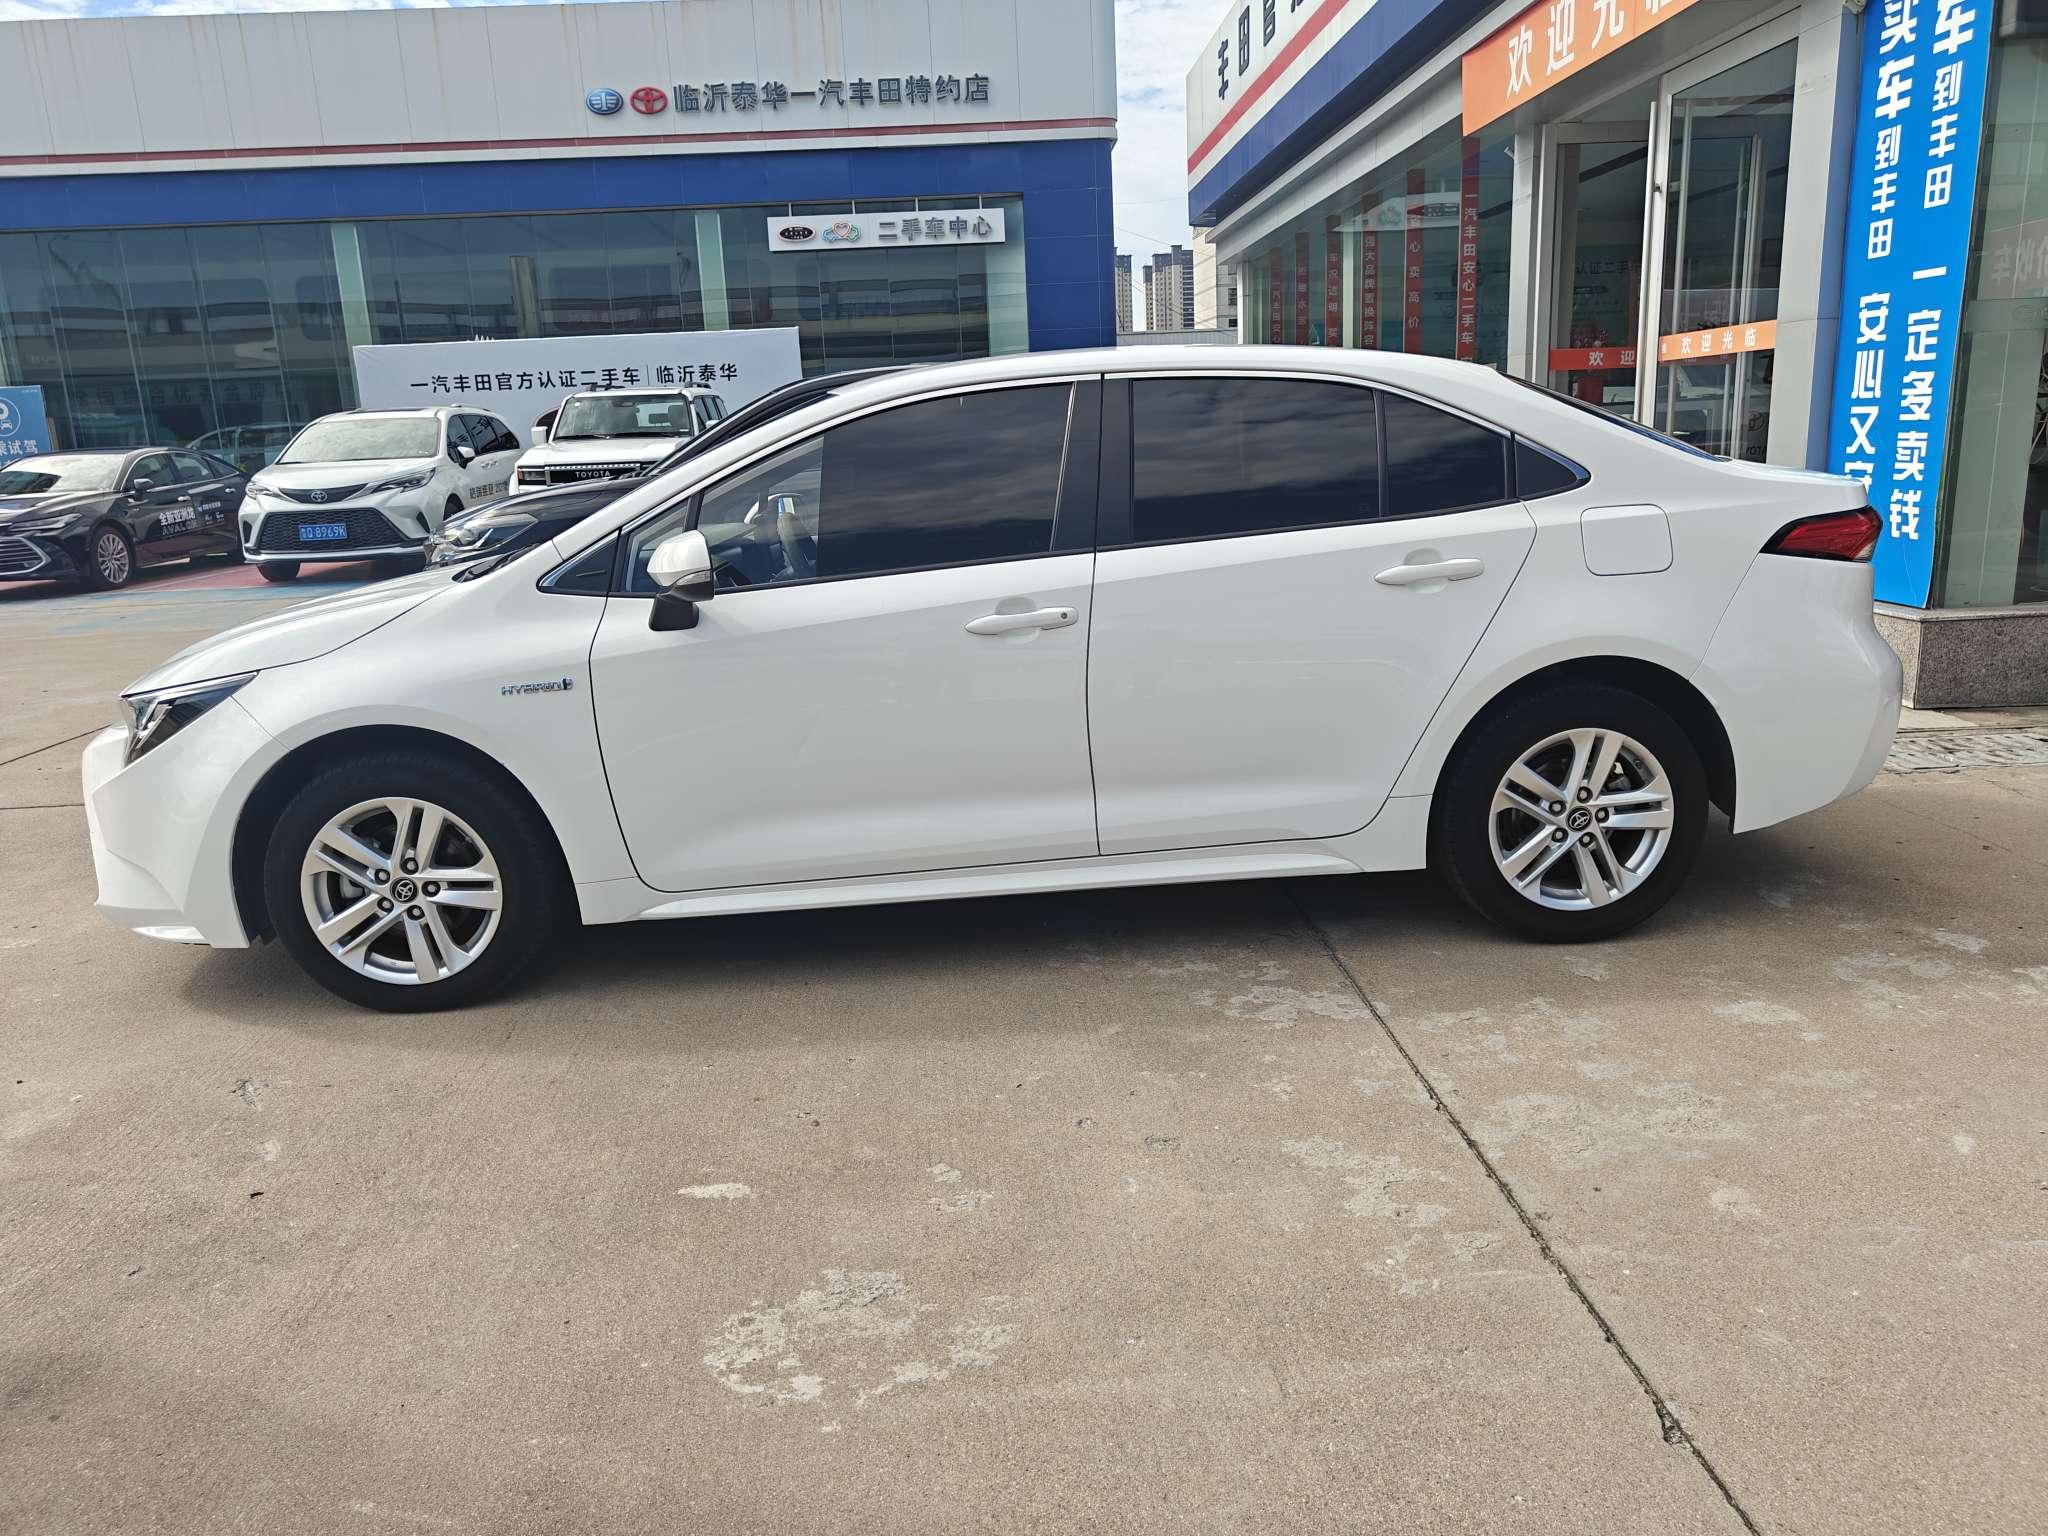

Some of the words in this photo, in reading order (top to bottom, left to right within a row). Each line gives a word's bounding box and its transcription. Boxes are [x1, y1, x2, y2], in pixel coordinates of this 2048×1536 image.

[1507, 0, 1673, 98] 欢迎光
[673, 73, 990, 113] 临沂泰华一汽丰田特约店
[879, 215, 993, 241] 二手车中心
[1681, 328, 1757, 355] 欢迎光临
[1588, 350, 1636, 366] 欢迎
[410, 366, 641, 393] 一汽丰田官方认证二手车
[656, 363, 739, 385] 临沂泰华
[1890, 266, 1948, 540] 一定多卖钱
[575, 470, 611, 478] TOYOTA
